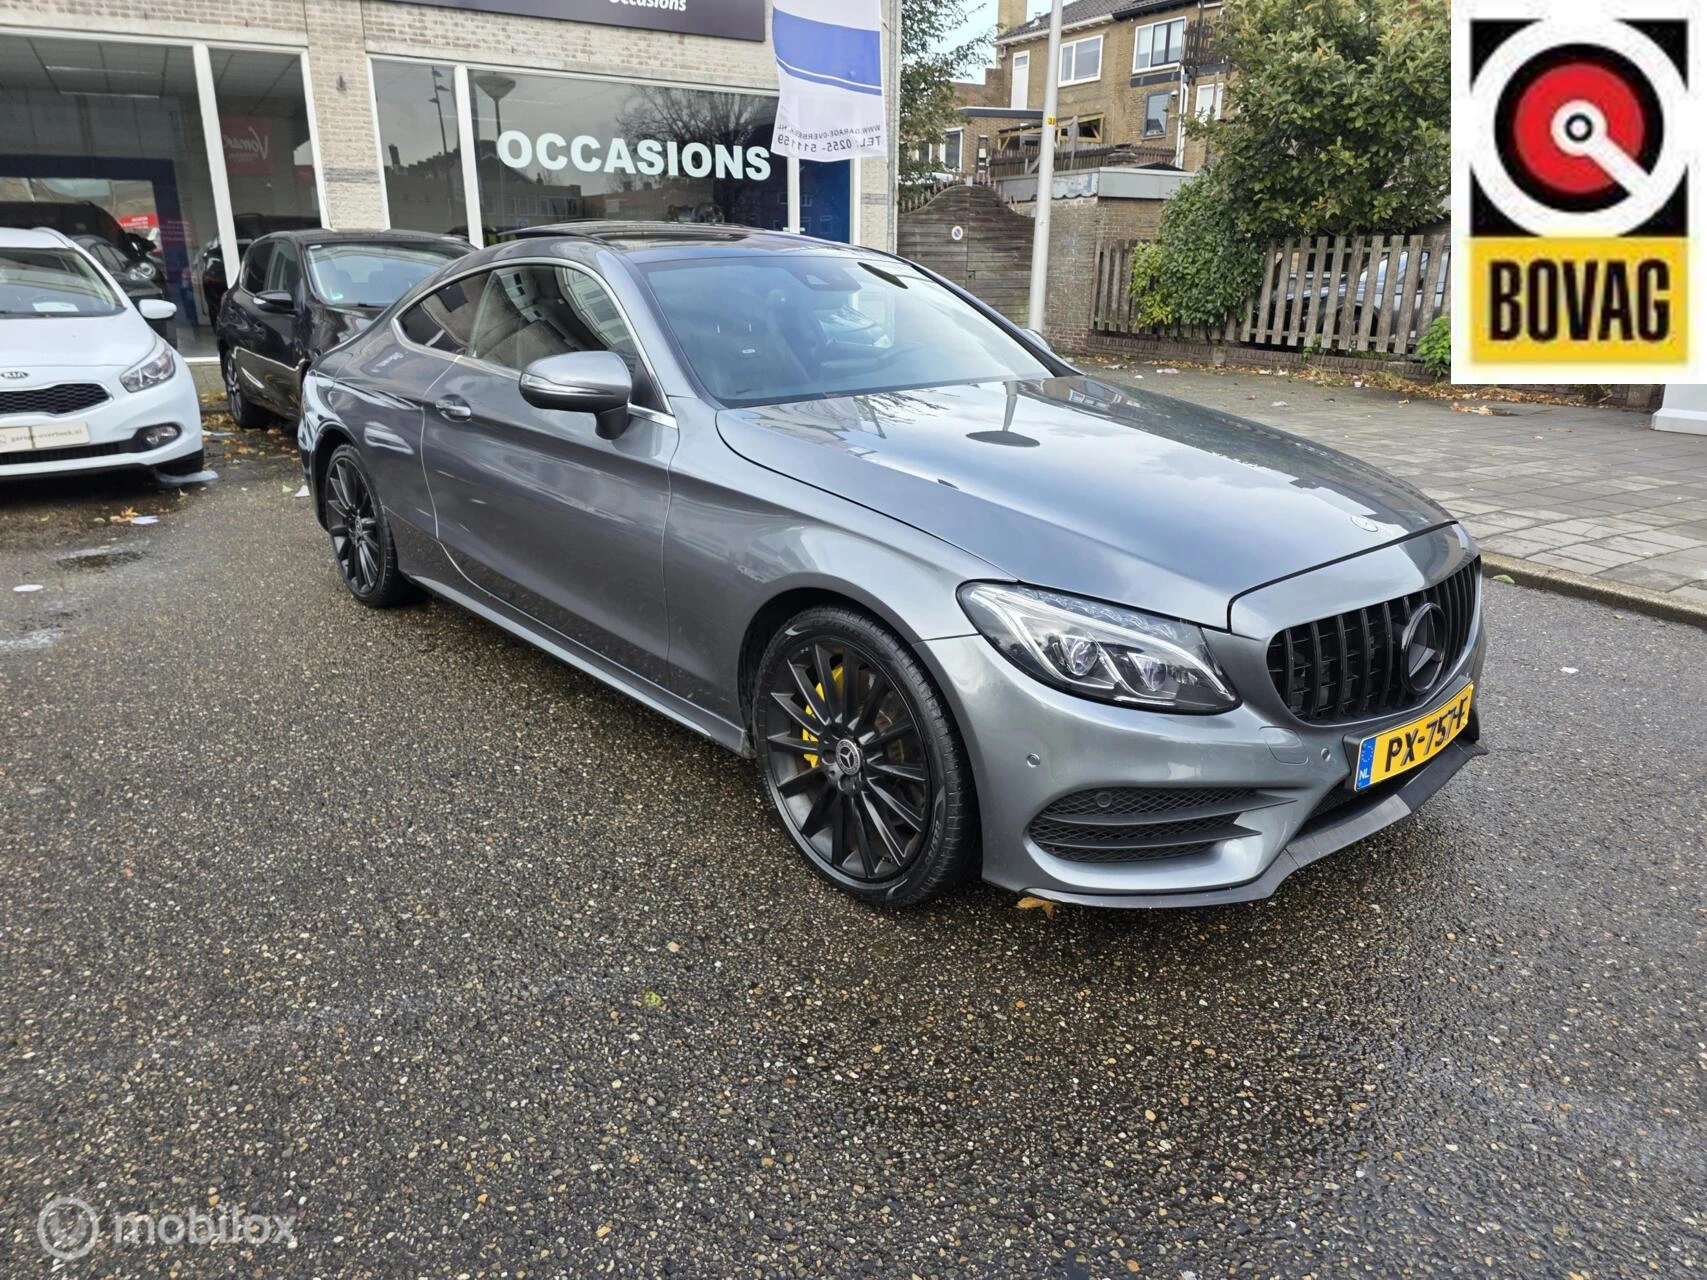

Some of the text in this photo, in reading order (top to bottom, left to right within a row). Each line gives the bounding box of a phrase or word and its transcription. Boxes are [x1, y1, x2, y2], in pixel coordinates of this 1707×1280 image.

[609, 0, 687, 11] asions
[496, 130, 772, 181] OCCASIONS
[1359, 768, 1370, 780] NL
